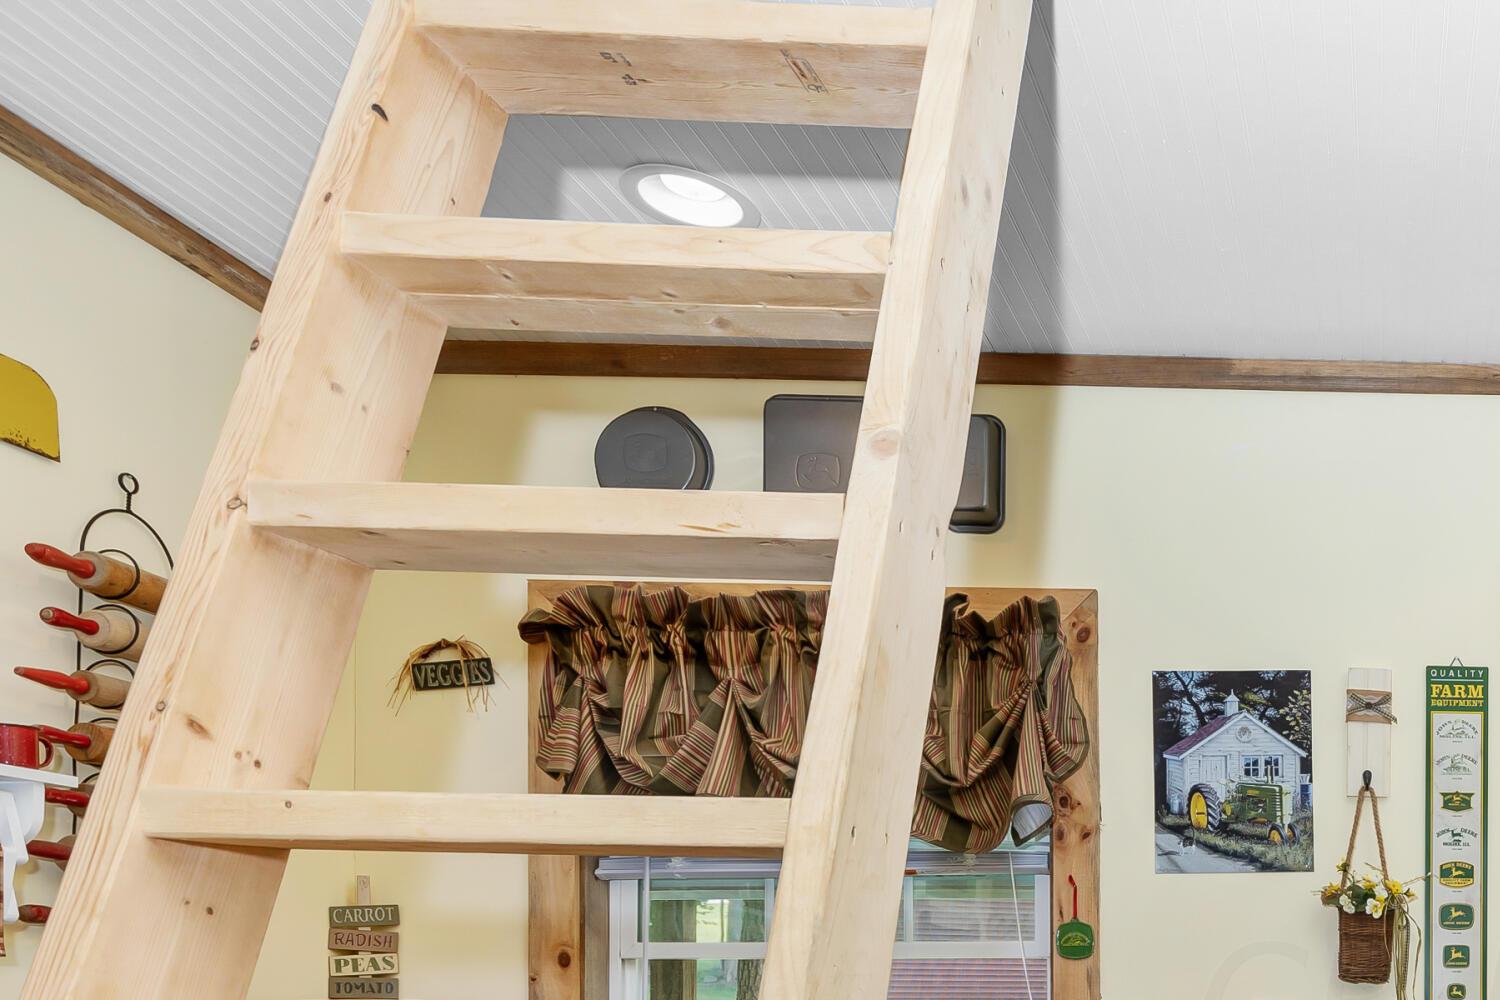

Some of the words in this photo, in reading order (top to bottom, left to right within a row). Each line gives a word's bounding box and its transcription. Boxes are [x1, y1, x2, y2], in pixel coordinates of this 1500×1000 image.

[413, 661, 492, 689] VEGGIES
[1430, 669, 1484, 678] QUALITY
[1430, 684, 1484, 699] FARM
[1430, 699, 1484, 707] EQUIPMENT
[333, 906, 395, 923] CARROT
[334, 932, 393, 949] RADISH
[334, 955, 395, 974] PEAS
[335, 981, 394, 995] TOMATO
